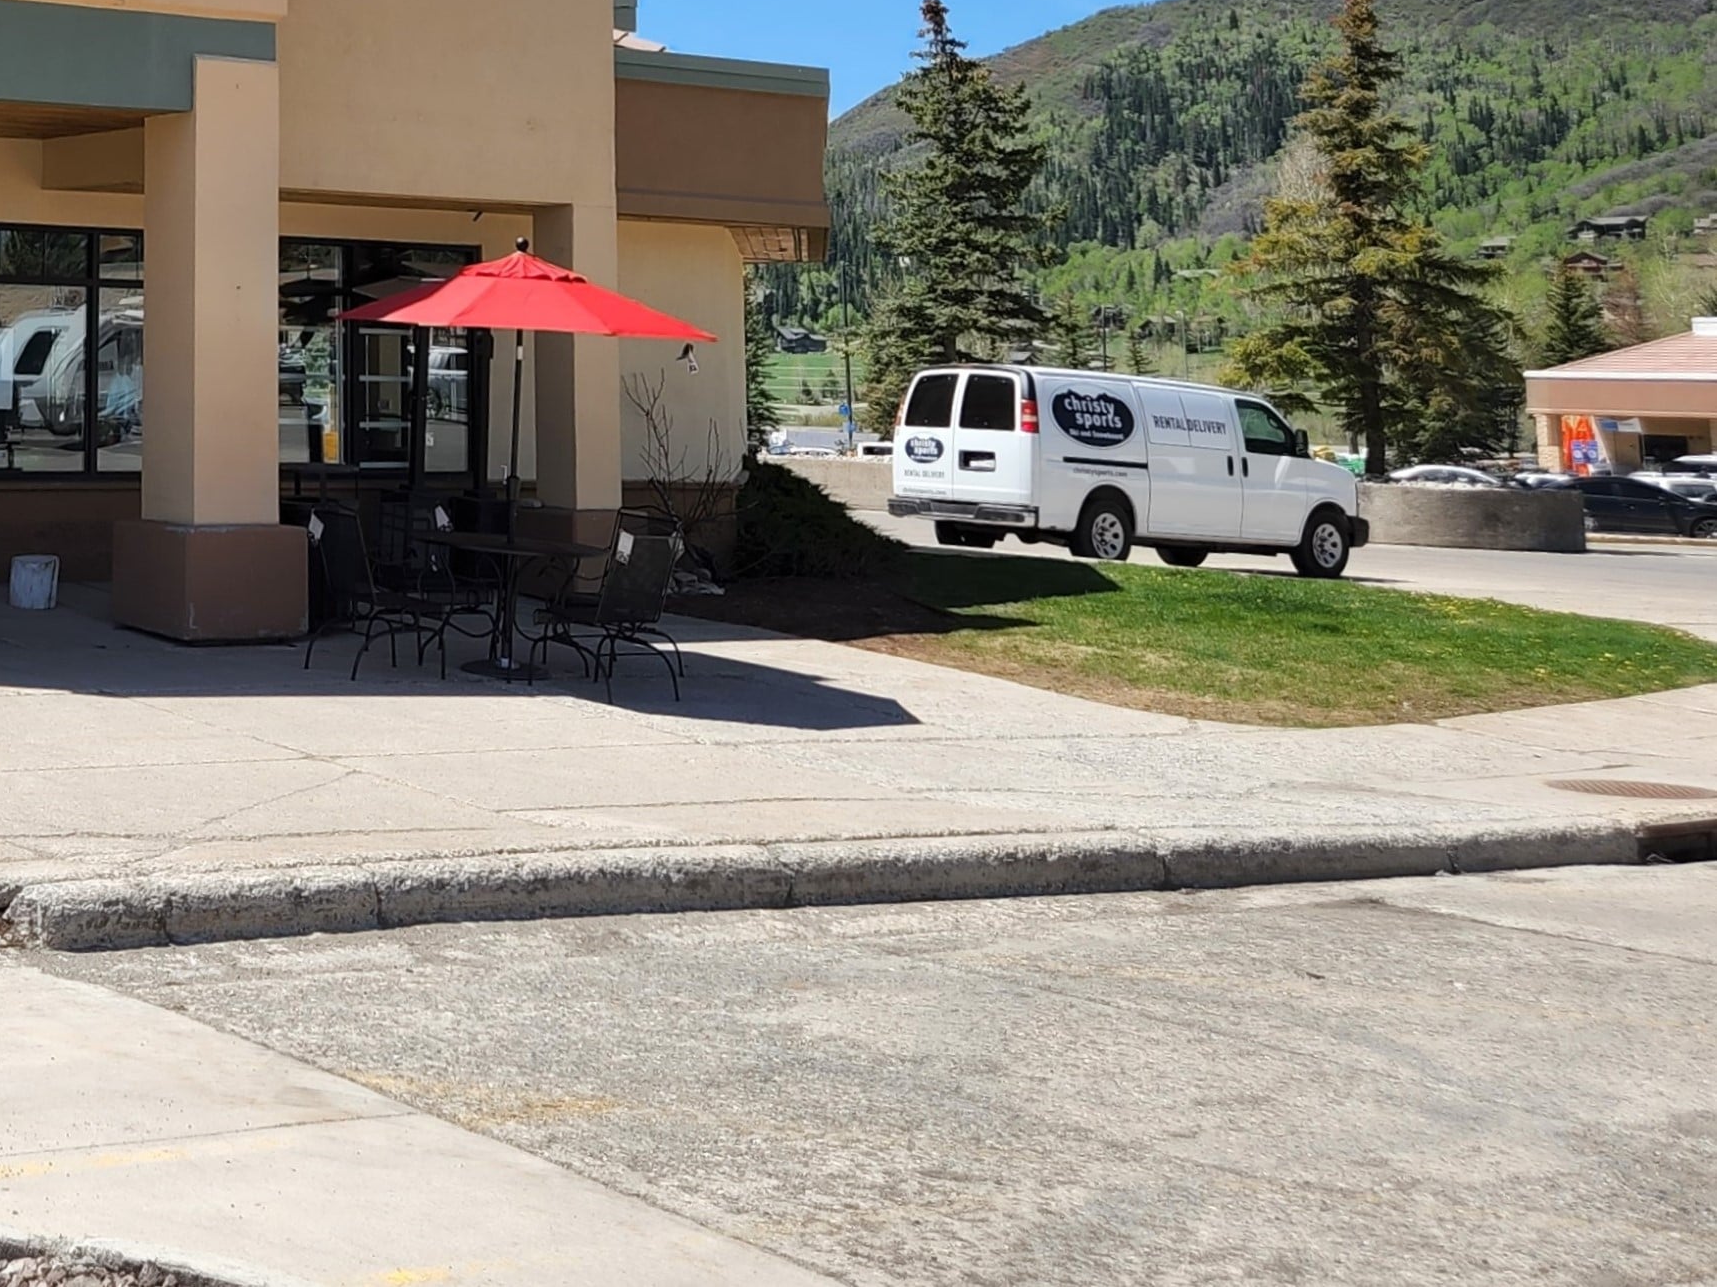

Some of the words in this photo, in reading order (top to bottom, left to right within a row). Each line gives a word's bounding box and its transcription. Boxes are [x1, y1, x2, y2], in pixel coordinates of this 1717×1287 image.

[1064, 395, 1115, 415] christy
[1075, 413, 1123, 429] sports
[1153, 415, 1186, 430] RENTAL
[1187, 418, 1227, 435] DELIVERY
